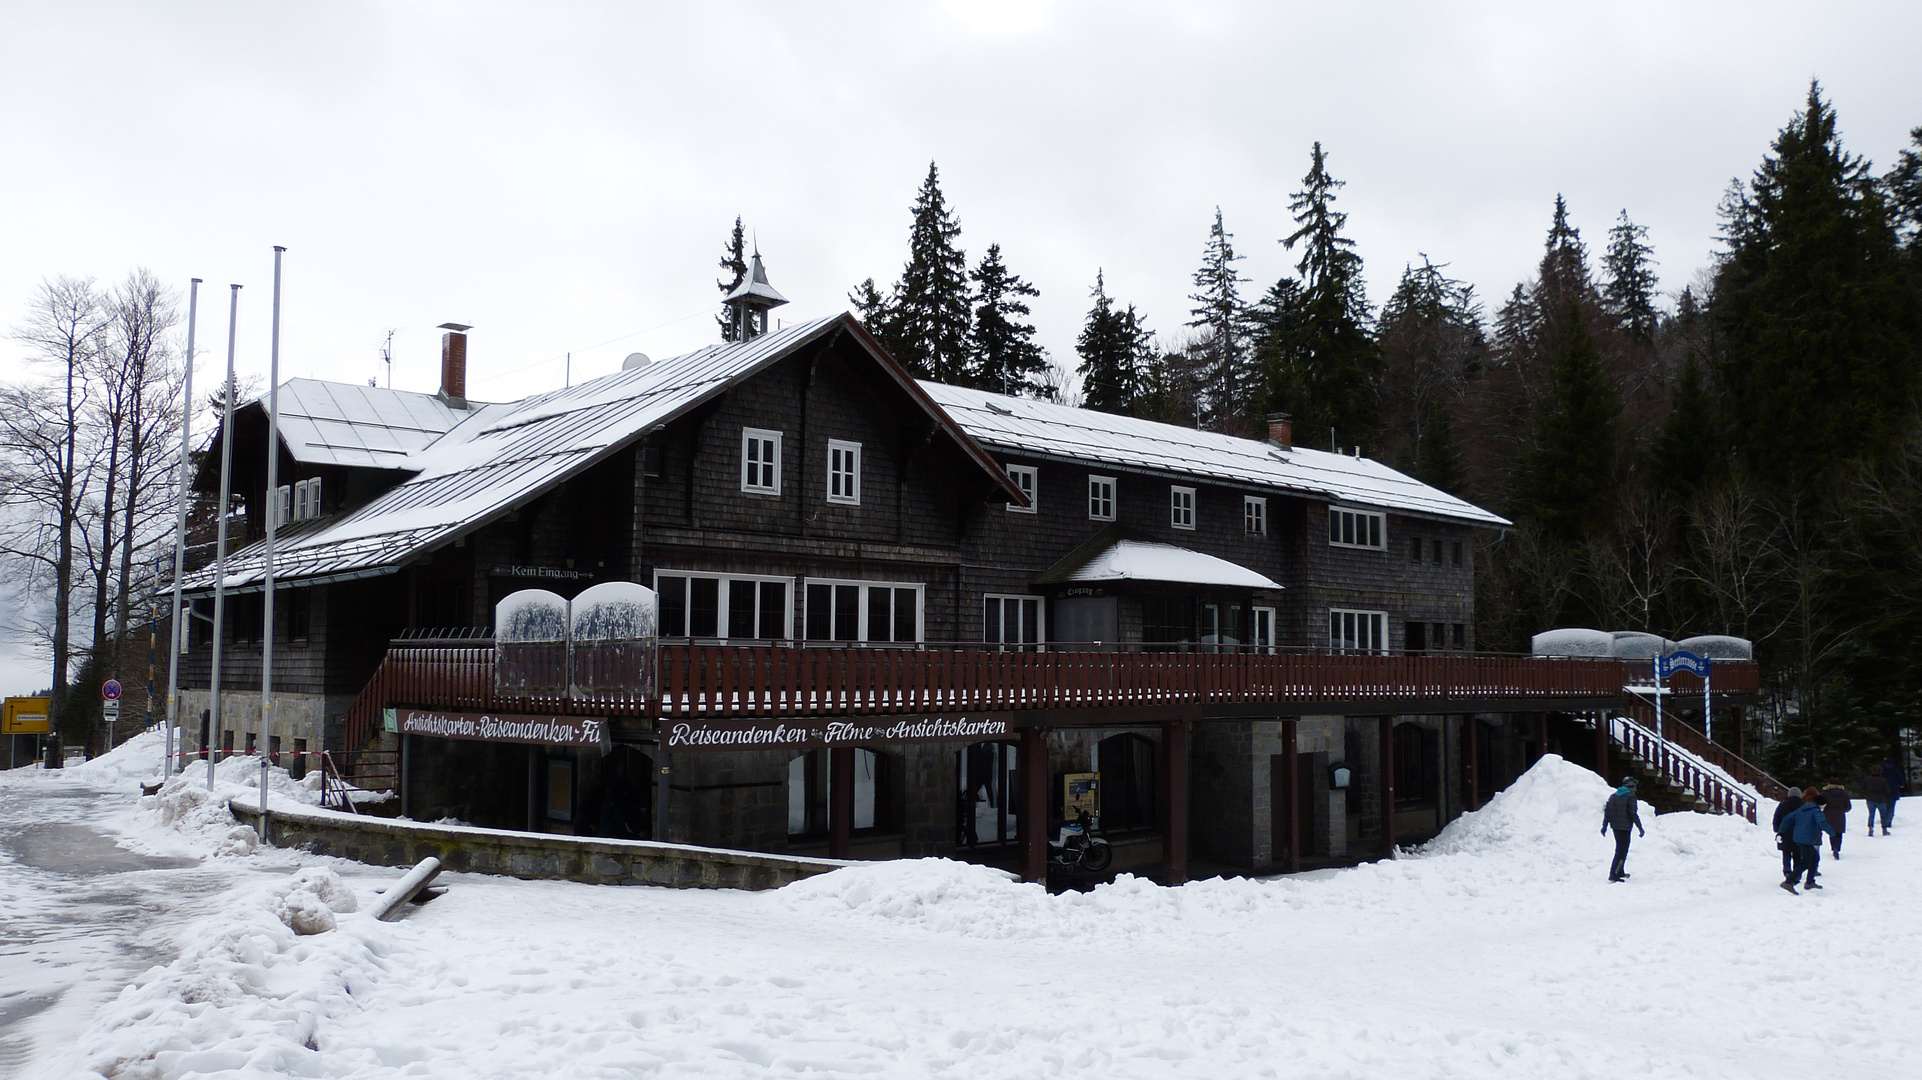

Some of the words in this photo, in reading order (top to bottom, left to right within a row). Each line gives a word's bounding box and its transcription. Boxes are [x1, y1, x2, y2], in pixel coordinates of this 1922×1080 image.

[511, 565, 536, 576] Kein
[538, 566, 579, 579] Eingang
[668, 722, 808, 746] Reiseandenken
[824, 721, 874, 743] Filme
[886, 716, 1006, 739] Ansichtskarten
